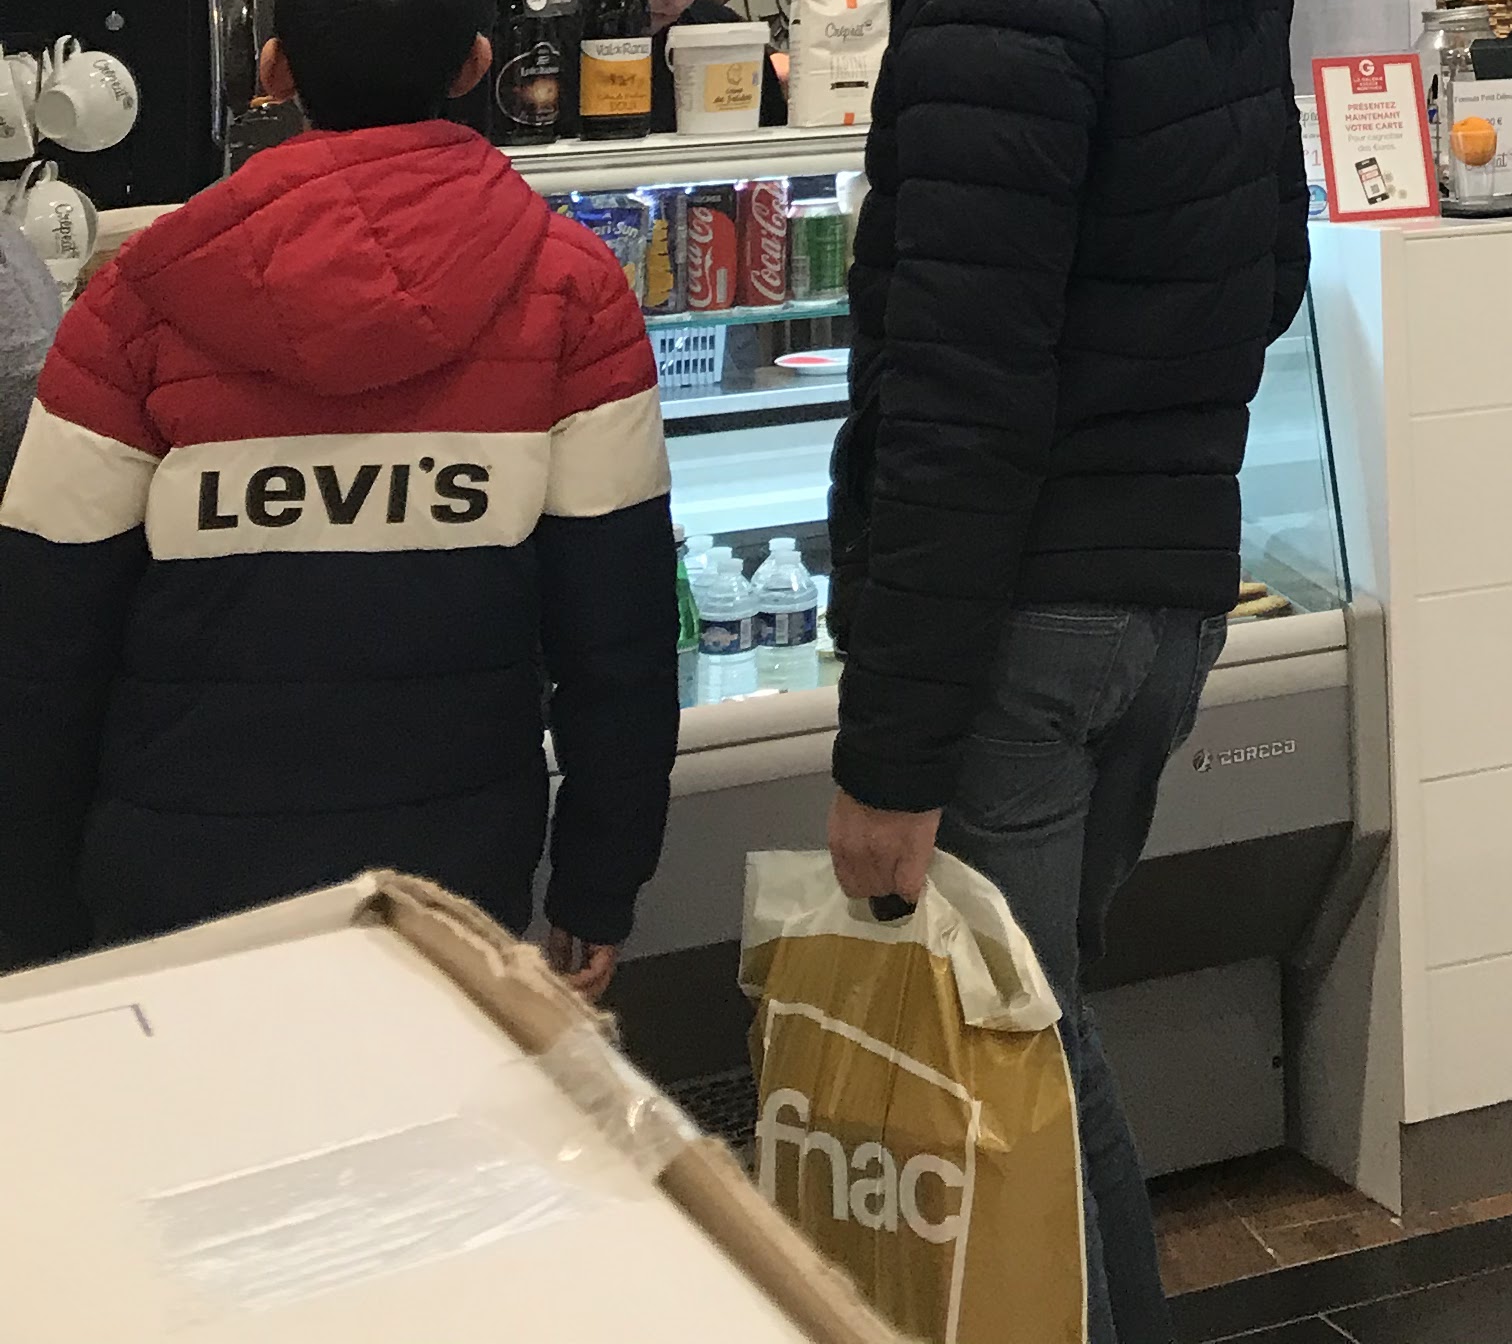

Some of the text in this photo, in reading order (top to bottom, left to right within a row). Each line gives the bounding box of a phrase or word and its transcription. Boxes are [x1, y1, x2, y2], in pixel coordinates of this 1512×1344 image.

[1348, 101, 1396, 111] PRÉSENTEZ
[1345, 112, 1401, 121] MAINTENANT
[1345, 121, 1404, 132] VOTRE CARTE
[757, 1086, 968, 1244] fnac
